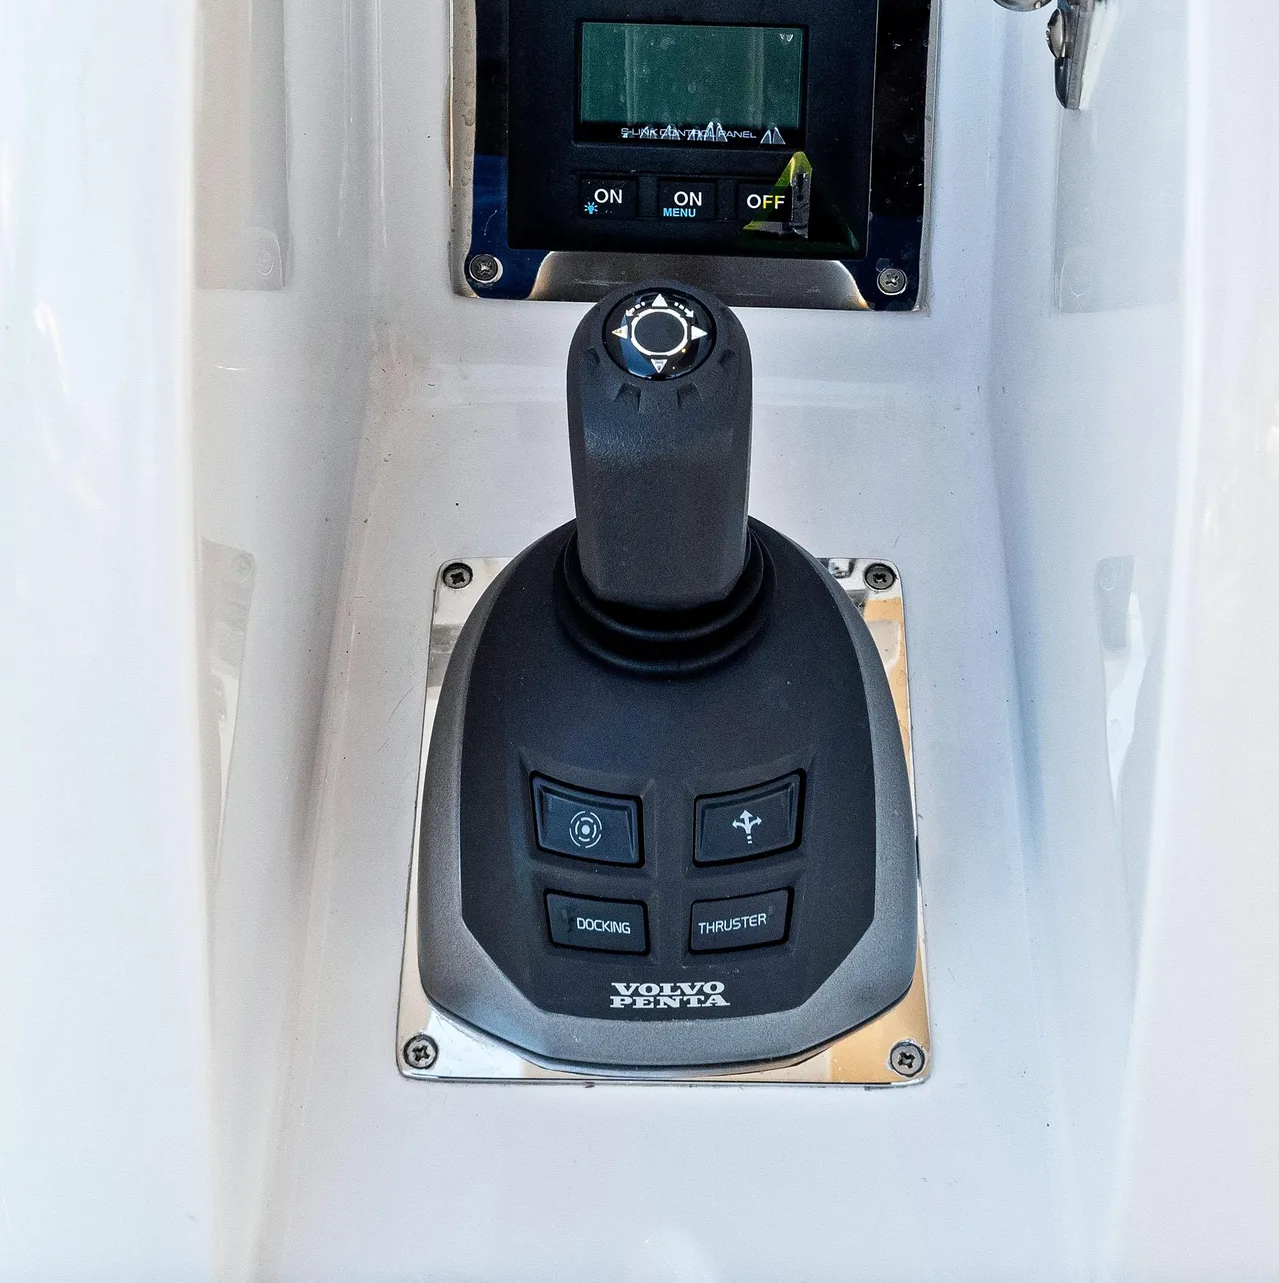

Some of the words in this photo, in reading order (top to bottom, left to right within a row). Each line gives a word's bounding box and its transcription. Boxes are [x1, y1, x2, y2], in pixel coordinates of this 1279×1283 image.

[718, 130, 757, 139] PANEL
[594, 188, 624, 204] ON
[673, 190, 702, 207] ON
[746, 194, 786, 210] OFF
[662, 207, 697, 218] MENU
[576, 916, 631, 935] DOCKING
[698, 912, 767, 935] THRUSTER
[610, 981, 725, 995] VOLVO
[609, 995, 730, 1008] PENTA
